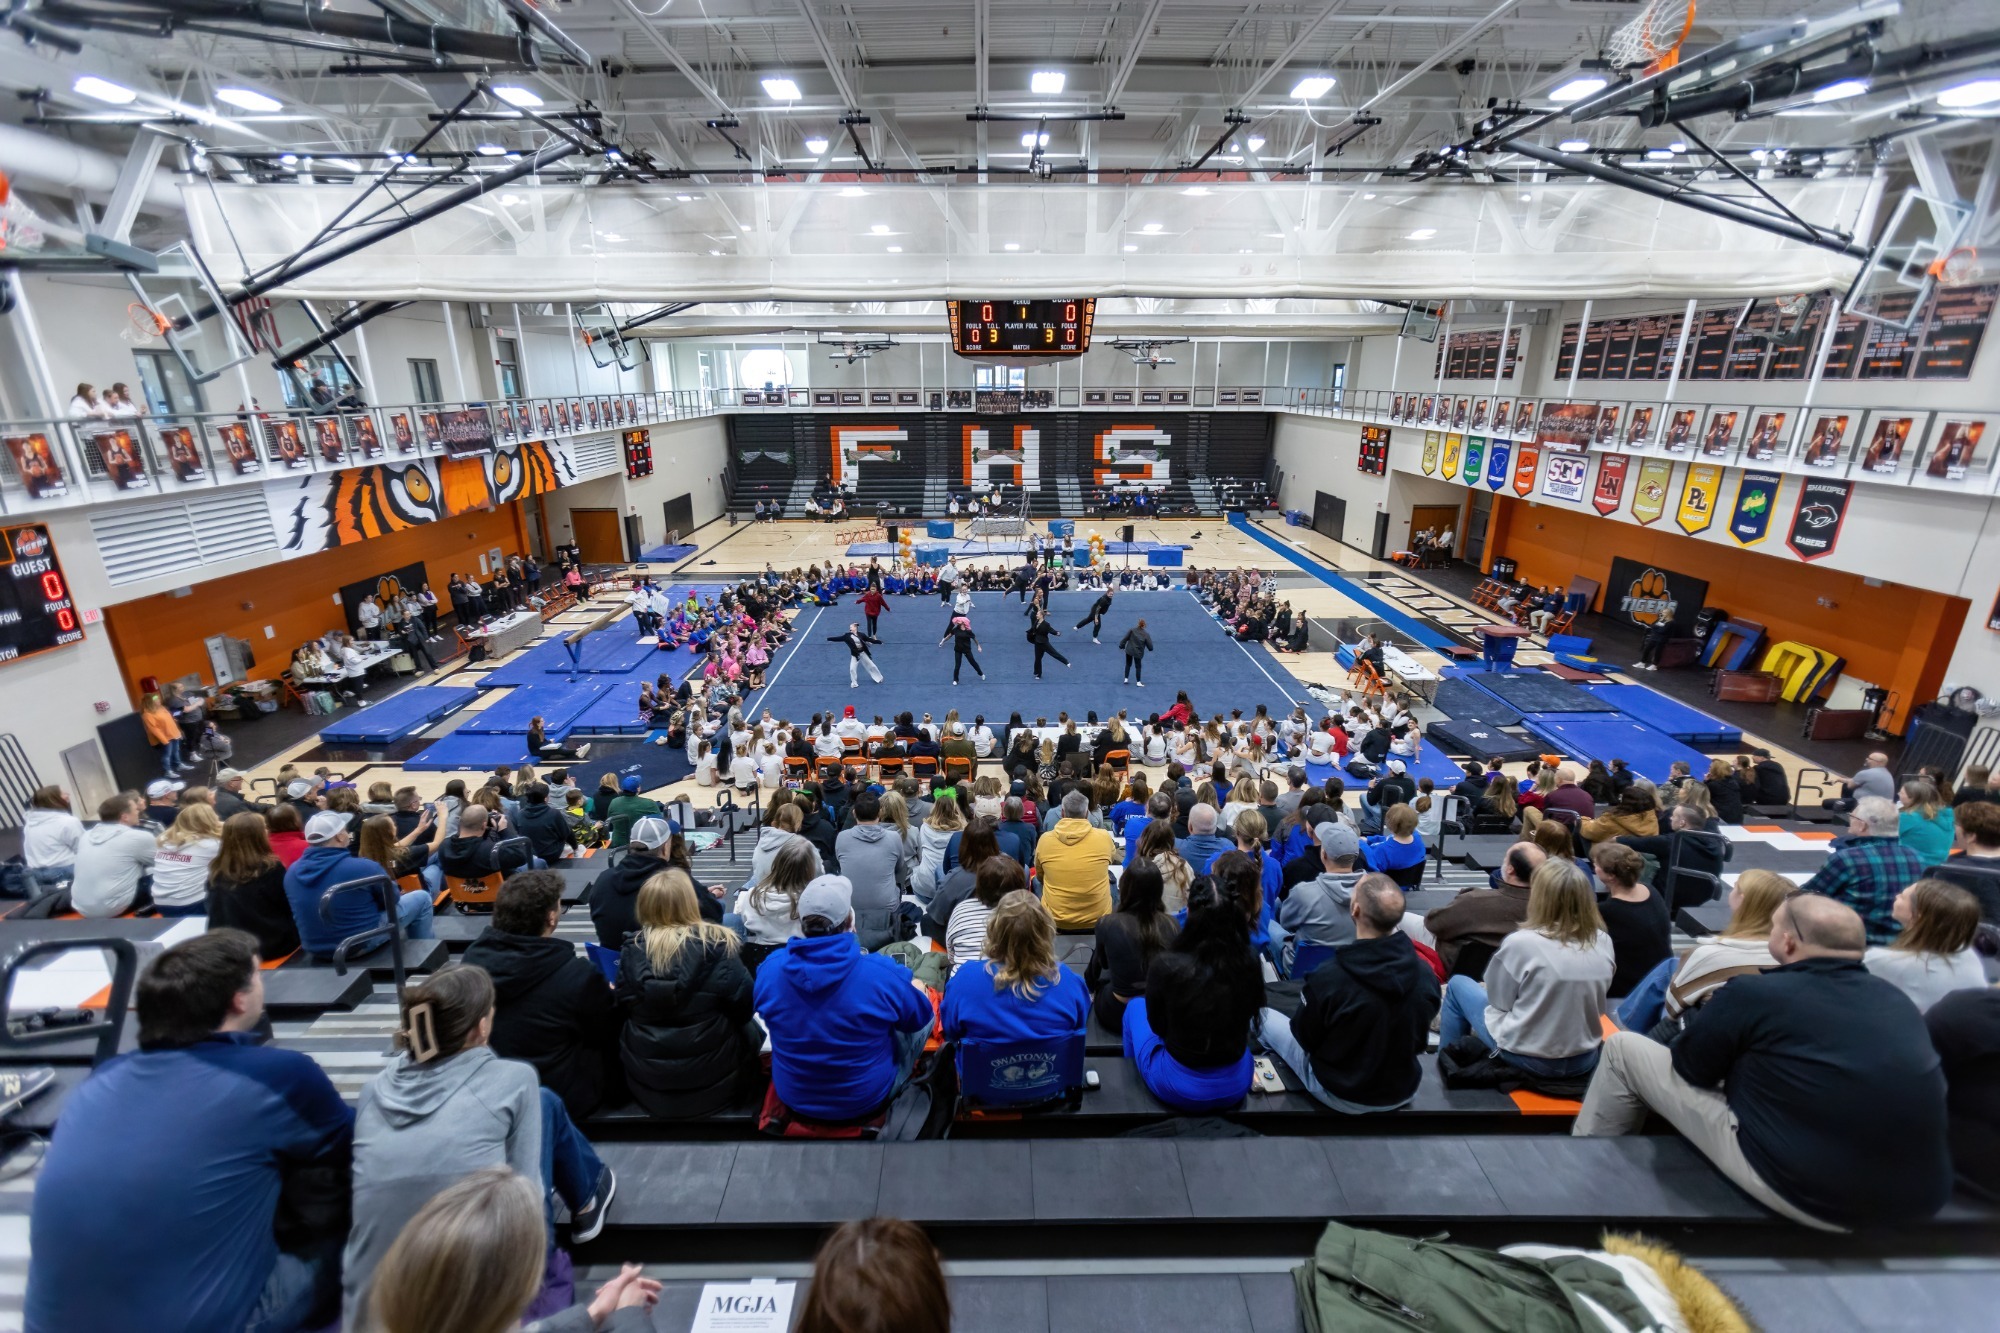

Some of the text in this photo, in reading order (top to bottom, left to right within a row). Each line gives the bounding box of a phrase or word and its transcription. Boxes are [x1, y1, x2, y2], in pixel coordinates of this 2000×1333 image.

[982, 304, 993, 322] 0
[1021, 307, 1027, 320] 1
[1066, 304, 1076, 322] 0
[971, 329, 980, 343] 0
[989, 329, 998, 343] 3
[1045, 329, 1054, 343] 3
[1066, 329, 1075, 343] 0
[1604, 455, 1626, 463] LAKEVILLE
[1601, 470, 1621, 497] LN
[1695, 476, 1712, 484] LAKE
[1744, 474, 1780, 484] ROSEMOUNT
[1807, 484, 1847, 496] SHAKOPEE
[1686, 486, 1708, 513] PL
[1738, 524, 1758, 534] IRISH
[16, 537, 48, 555] TIGERS
[1795, 535, 1828, 548] SABERS
[12, 558, 52, 577] GUEST
[43, 572, 65, 600] 0
[45, 600, 71, 613] FOULS
[1620, 595, 1678, 614] TIGERS
[0, 611, 21, 625] FOUL
[58, 609, 74, 630] 0
[84, 609, 99, 622] EXIT
[57, 631, 83, 645] SCORE
[460, 884, 490, 894] Tigers
[990, 1053, 1057, 1067] OWATONNA
[710, 1295, 778, 1314] MGJA
